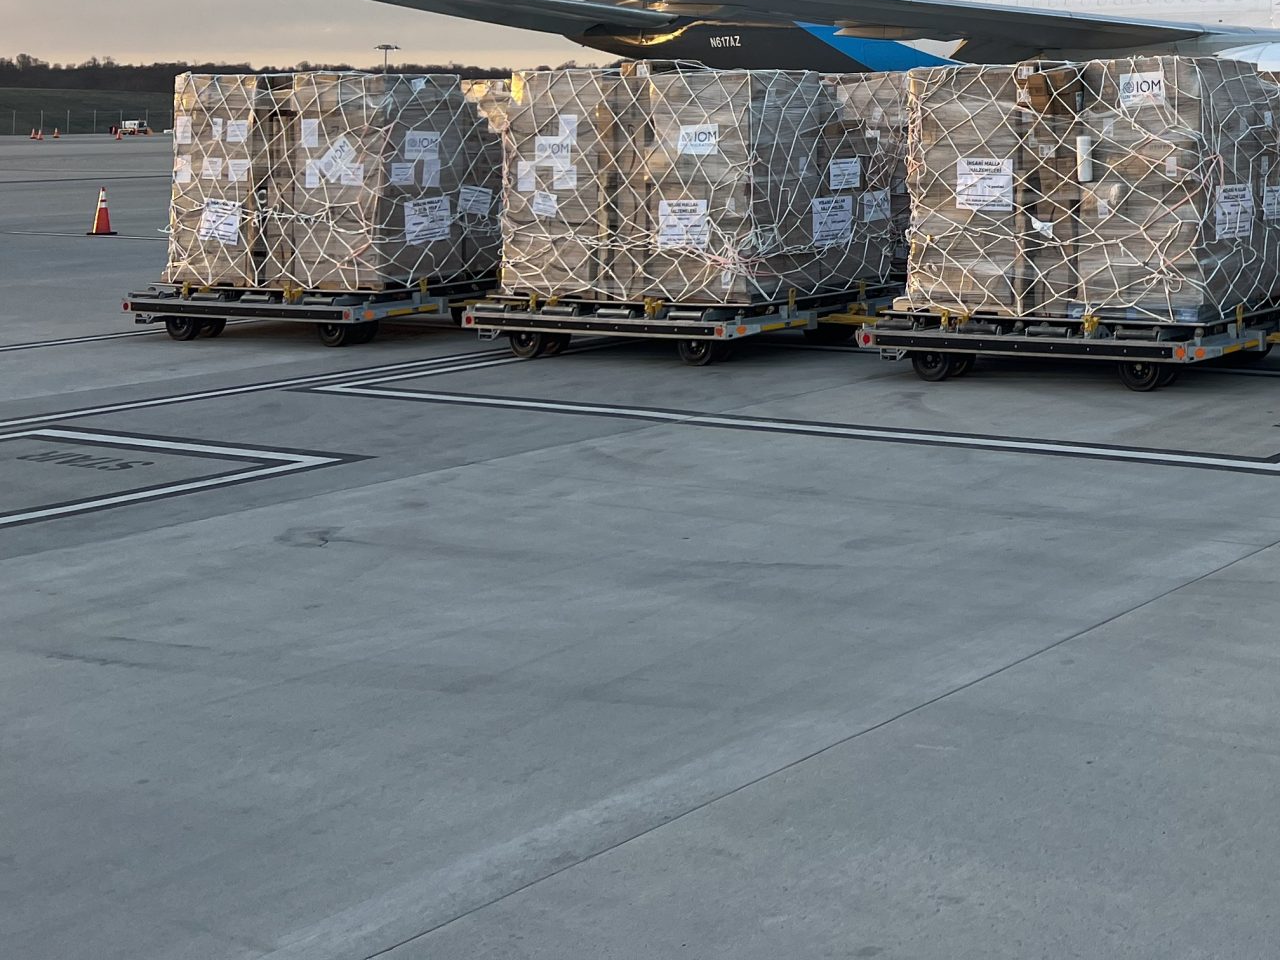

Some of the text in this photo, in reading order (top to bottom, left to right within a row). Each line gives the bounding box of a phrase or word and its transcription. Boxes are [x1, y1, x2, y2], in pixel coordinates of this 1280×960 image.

[710, 35, 741, 48] N617AZ
[1136, 79, 1161, 93] IOM
[694, 130, 717, 143] IOM
[16, 451, 155, 471] STAIR
